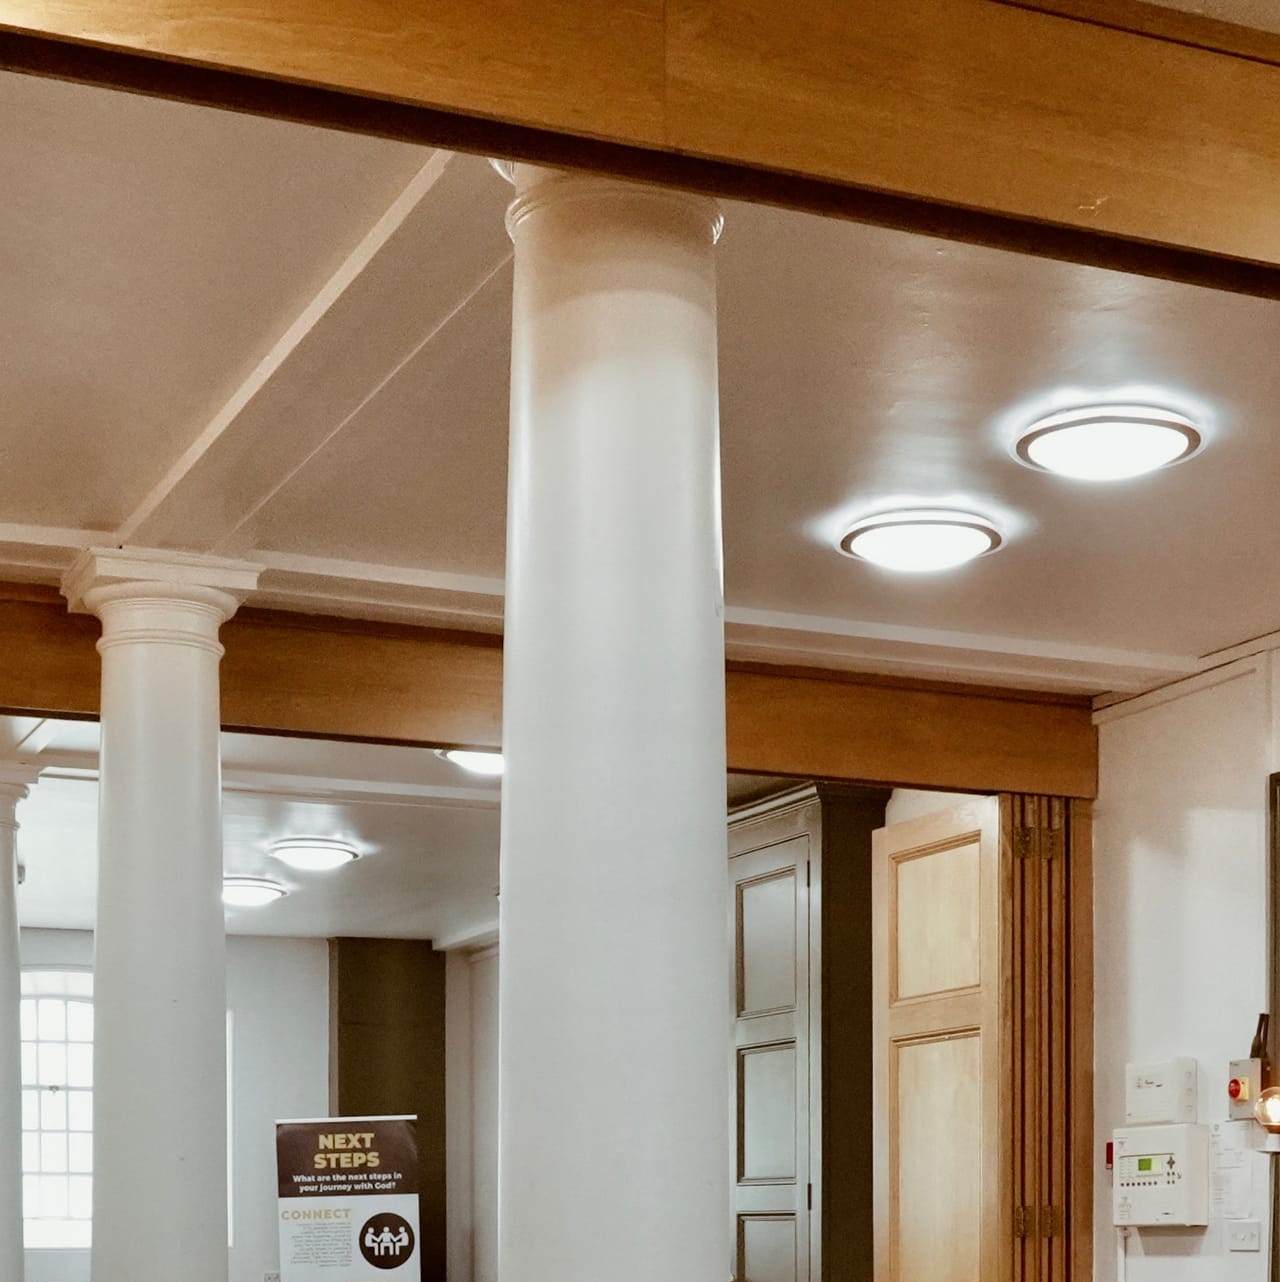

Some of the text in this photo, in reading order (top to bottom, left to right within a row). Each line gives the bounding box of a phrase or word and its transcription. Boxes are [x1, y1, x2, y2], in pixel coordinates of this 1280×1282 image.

[318, 1133, 375, 1150] NEXT
[313, 1151, 380, 1169] STEPS
[293, 1171, 402, 1183] What are the next steps in
[299, 1181, 396, 1193] your journey with God?
[280, 1208, 352, 1220] CONNECT
